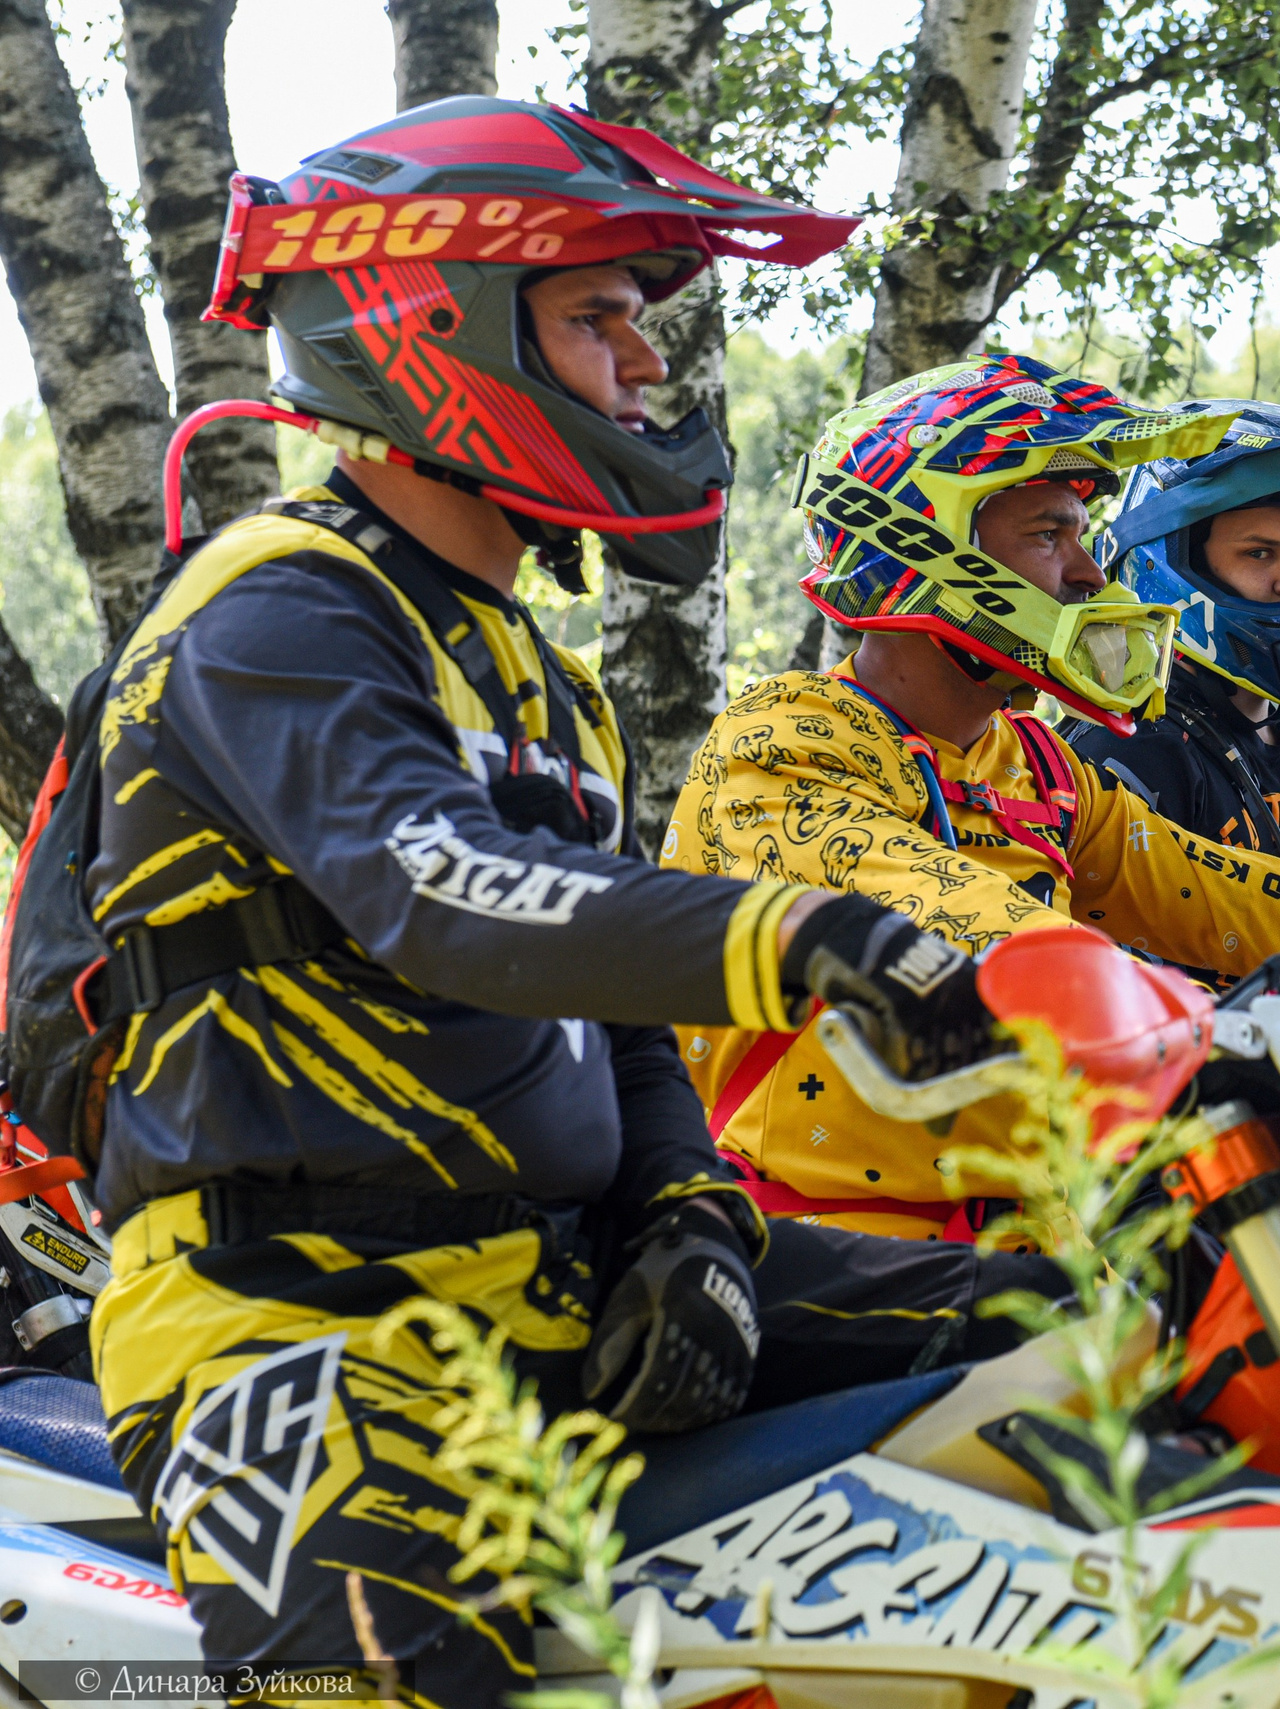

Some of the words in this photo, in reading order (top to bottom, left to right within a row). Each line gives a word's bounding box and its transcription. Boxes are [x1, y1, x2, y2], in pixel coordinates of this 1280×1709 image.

[263, 198, 569, 267] 100%
[805, 471, 1028, 617] 100%
[46, 1236, 88, 1266] ENDURO
[46, 1247, 84, 1274] ELEMENT
